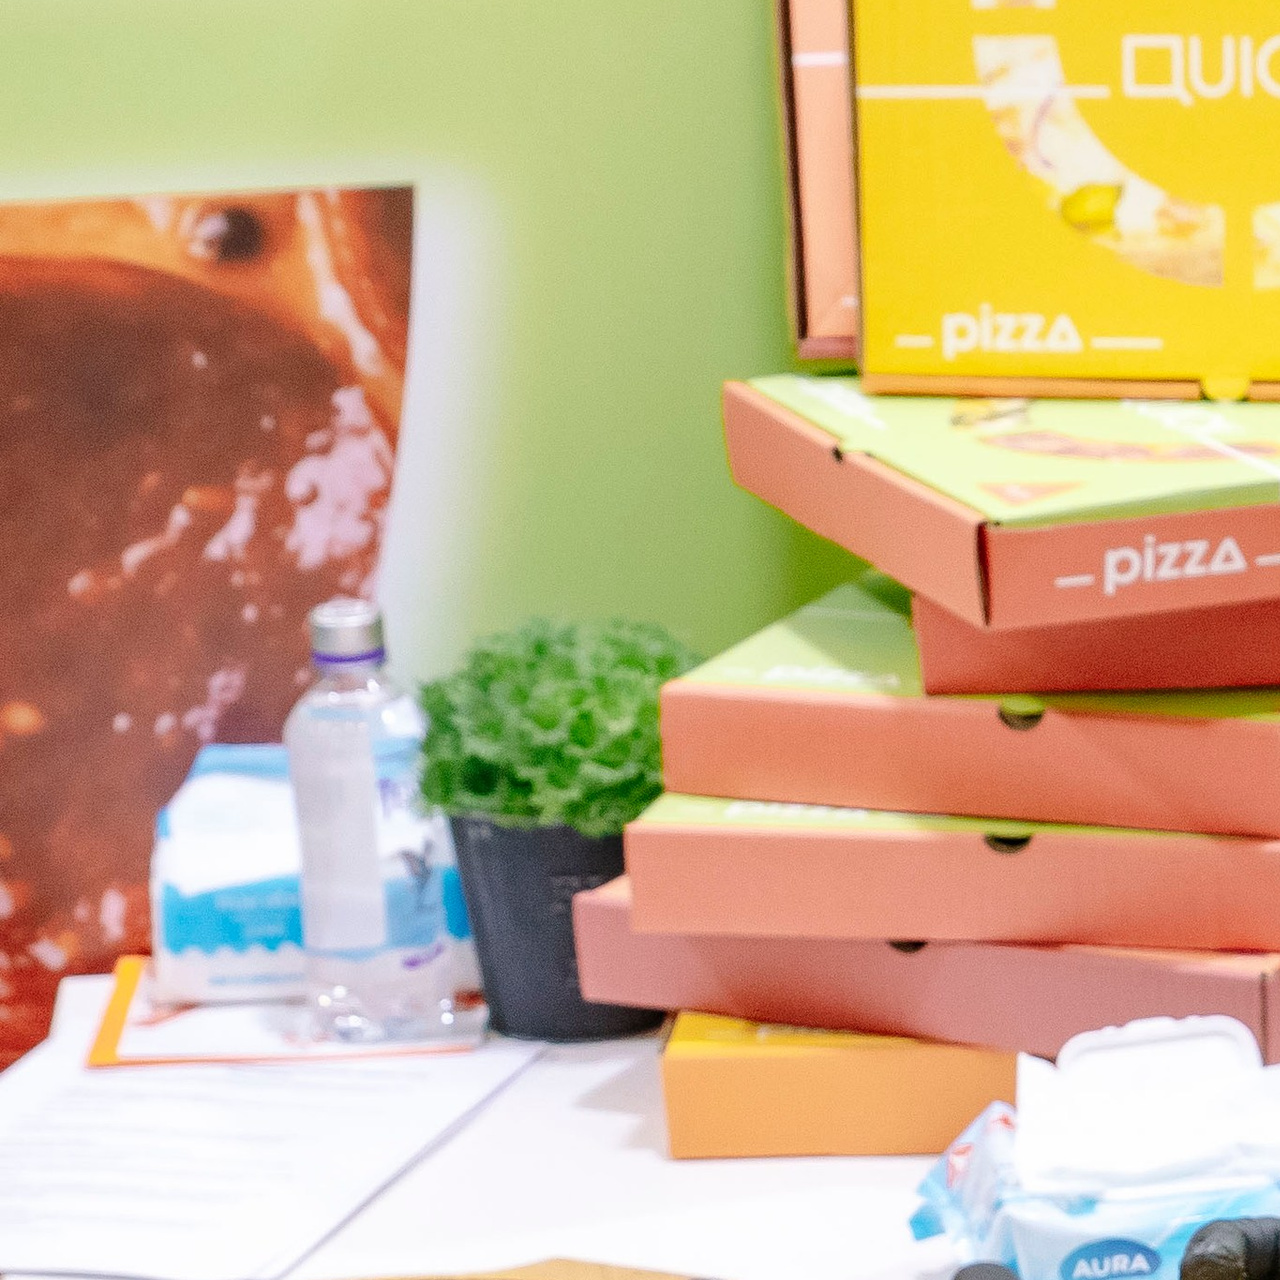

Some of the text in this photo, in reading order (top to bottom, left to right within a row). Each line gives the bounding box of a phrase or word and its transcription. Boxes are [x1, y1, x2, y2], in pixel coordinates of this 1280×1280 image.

[941, 302, 1083, 361] pizza
[1103, 533, 1247, 596] pizza
[1072, 1253, 1151, 1279] AURA
